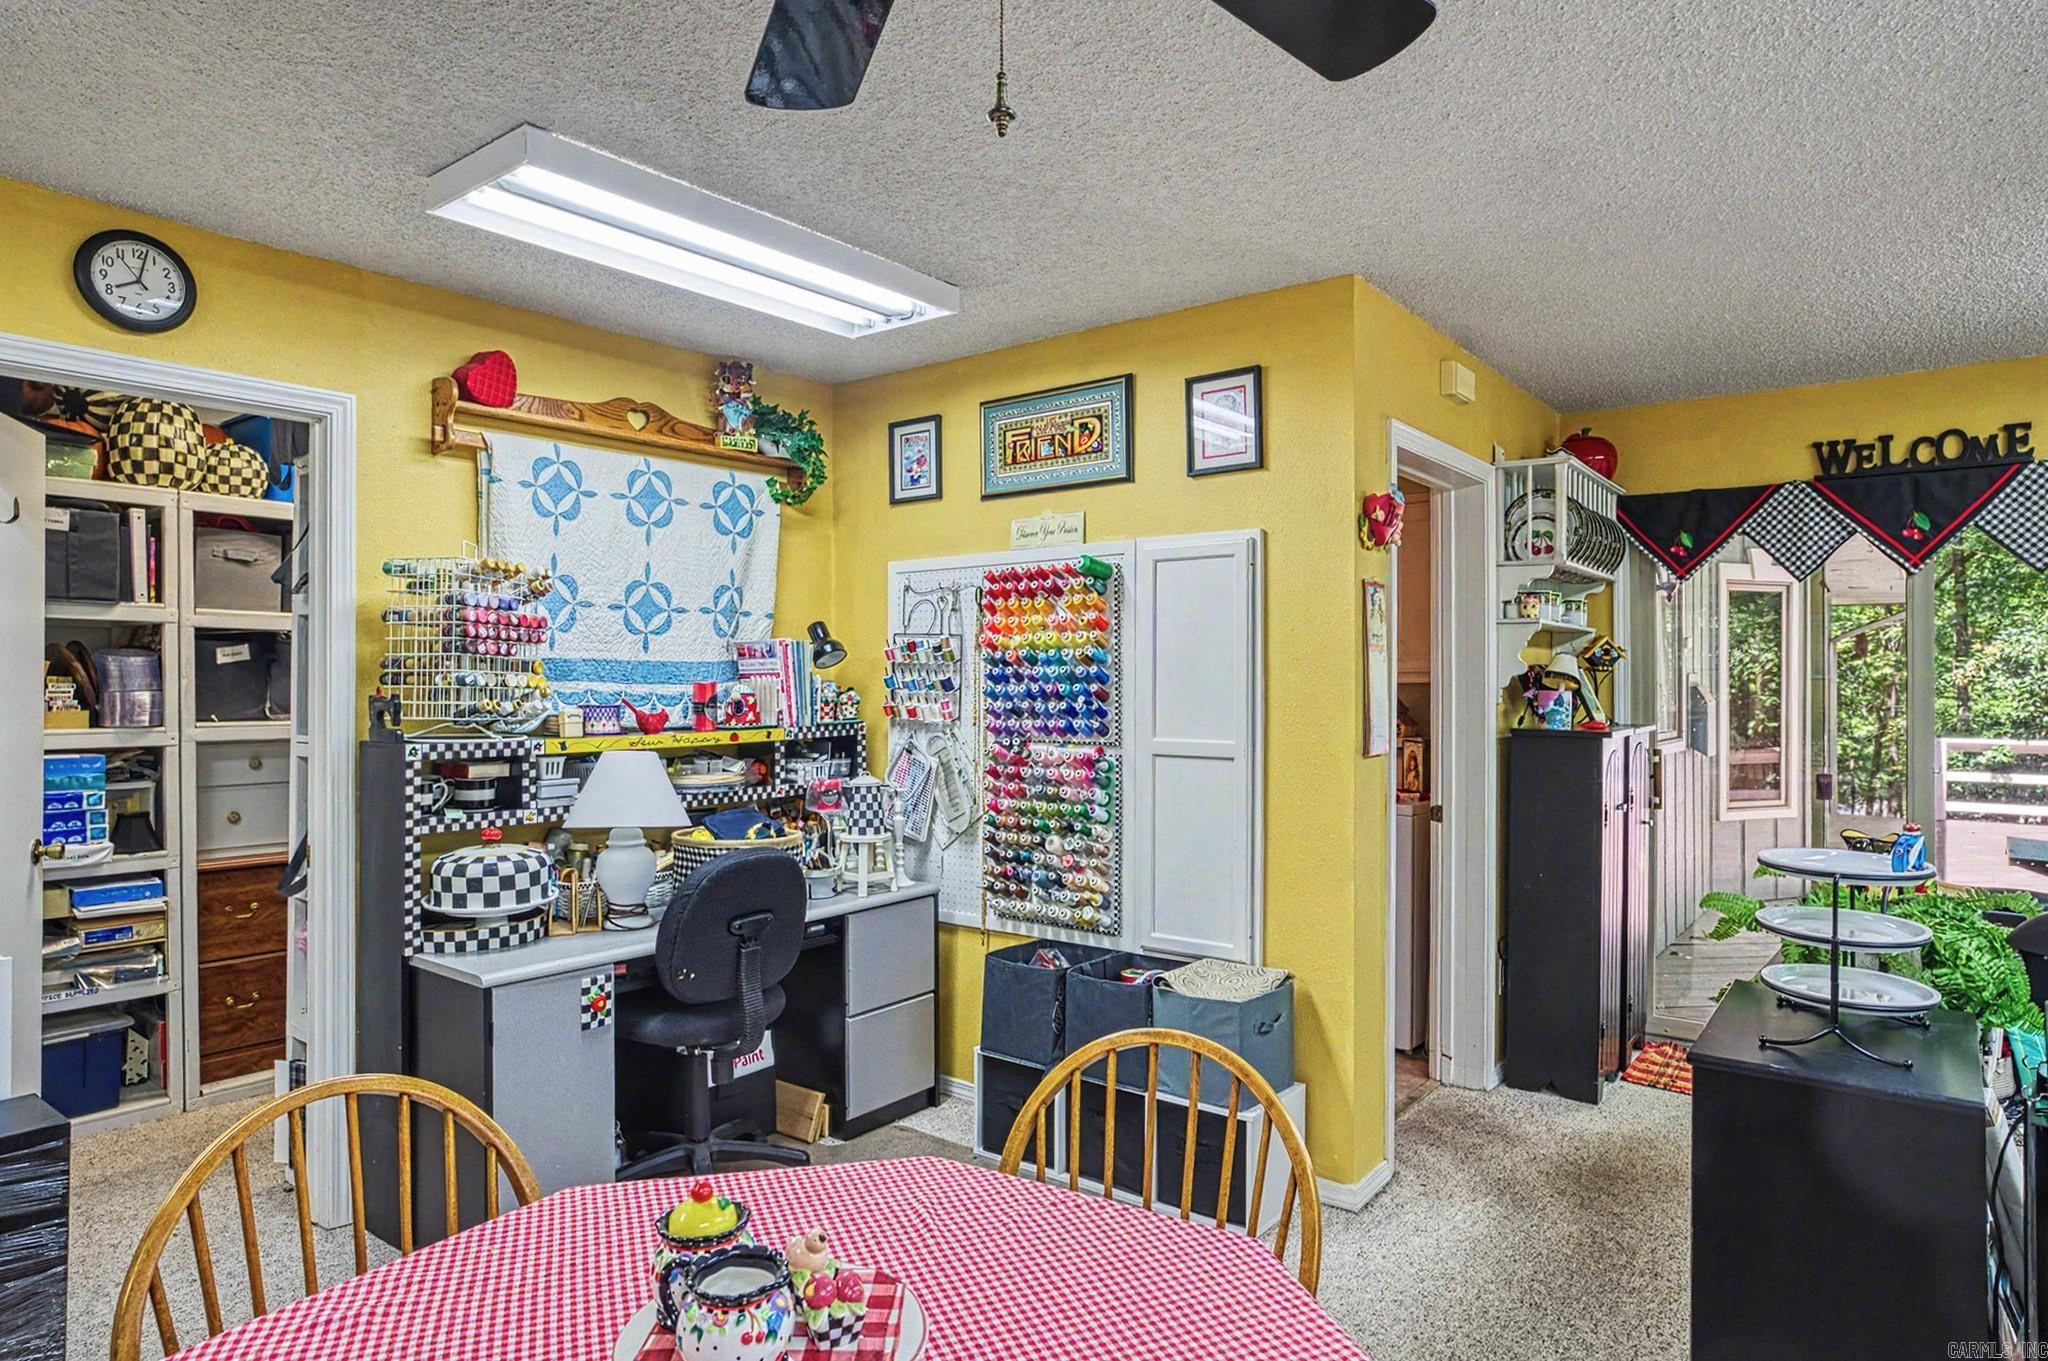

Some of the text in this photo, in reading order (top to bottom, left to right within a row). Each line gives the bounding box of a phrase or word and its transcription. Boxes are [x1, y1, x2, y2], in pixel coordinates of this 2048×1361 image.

[132, 247, 144, 260] 12
[102, 254, 114, 267] 10
[152, 256, 156, 266] 1
[99, 269, 108, 280] 9
[163, 267, 171, 279] 2
[105, 283, 113, 295] 8
[168, 282, 176, 293] 3
[1005, 416, 1102, 464] FRIEND
[1812, 422, 2034, 476] WELCOME
[629, 734, 721, 747] Sew Happy
[731, 1048, 765, 1069] Paint
